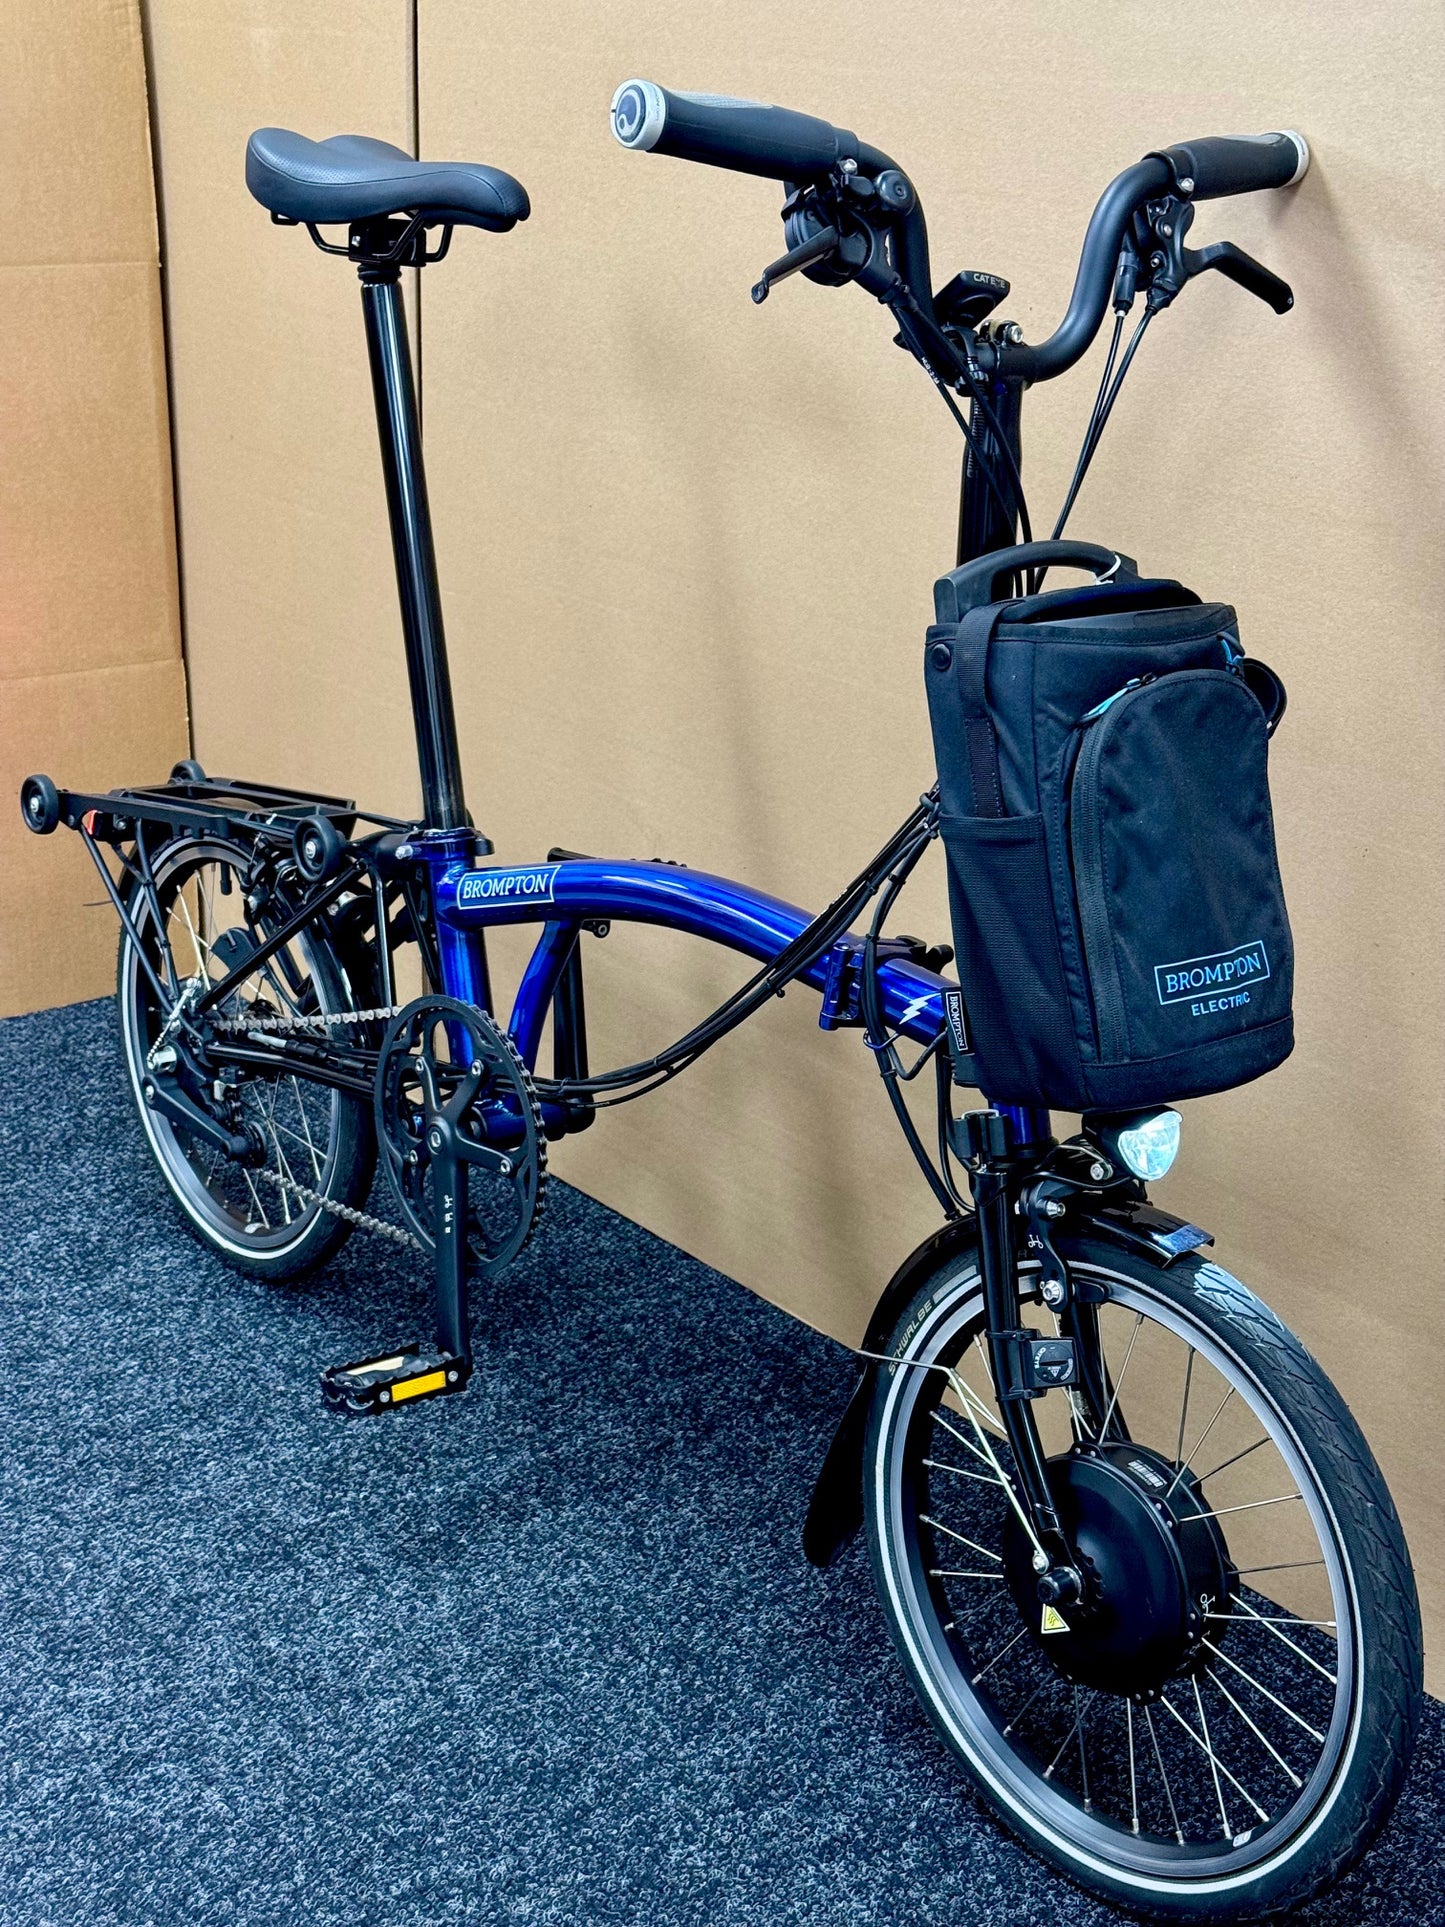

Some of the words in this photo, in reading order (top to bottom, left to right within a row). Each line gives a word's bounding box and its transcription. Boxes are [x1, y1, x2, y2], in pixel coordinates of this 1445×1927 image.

[462, 873, 549, 899] BROMPTON
[1165, 952, 1261, 993] BROMPTON
[1191, 991, 1250, 1016] ELECTRIC
[949, 995, 965, 1047] BROMPTON
